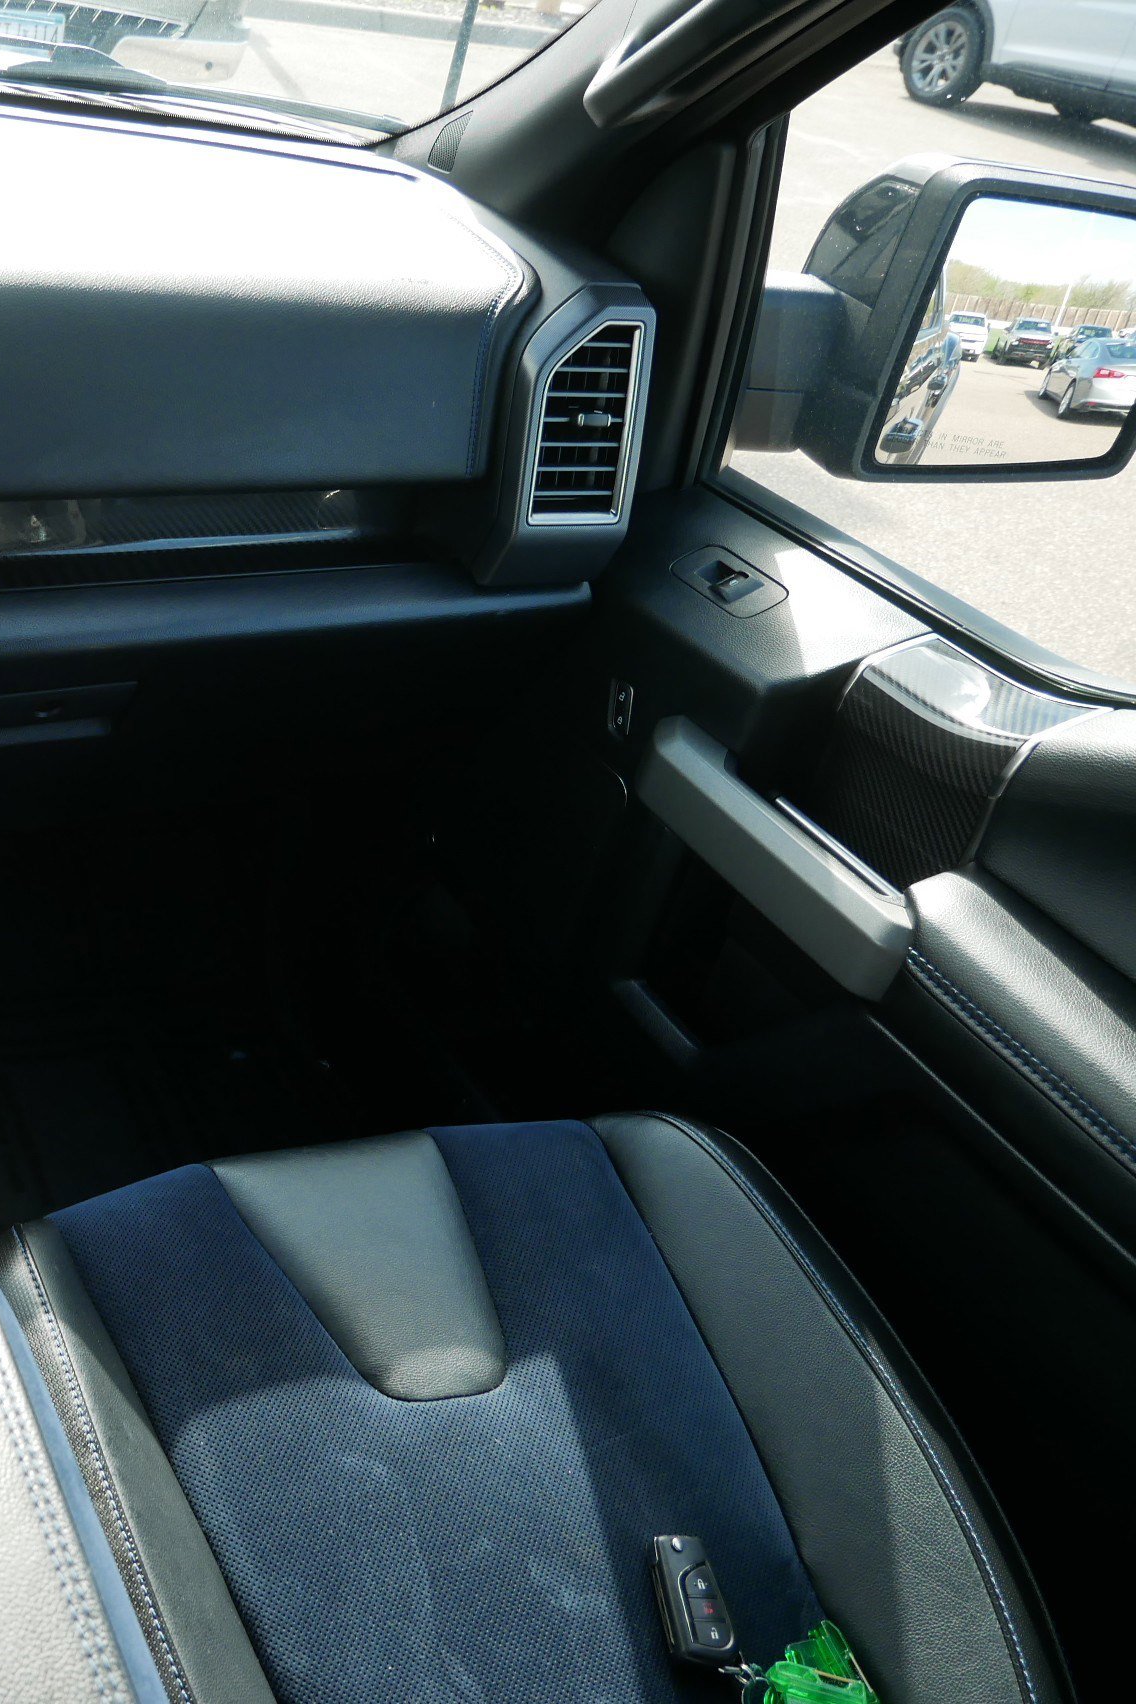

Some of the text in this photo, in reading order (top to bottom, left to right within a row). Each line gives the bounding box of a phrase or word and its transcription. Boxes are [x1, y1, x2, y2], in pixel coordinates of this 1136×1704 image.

[952, 434, 985, 446] MIRROR
[987, 439, 1005, 450] ARE
[949, 444, 971, 454] THEY
[973, 448, 1007, 458] APPEAR
